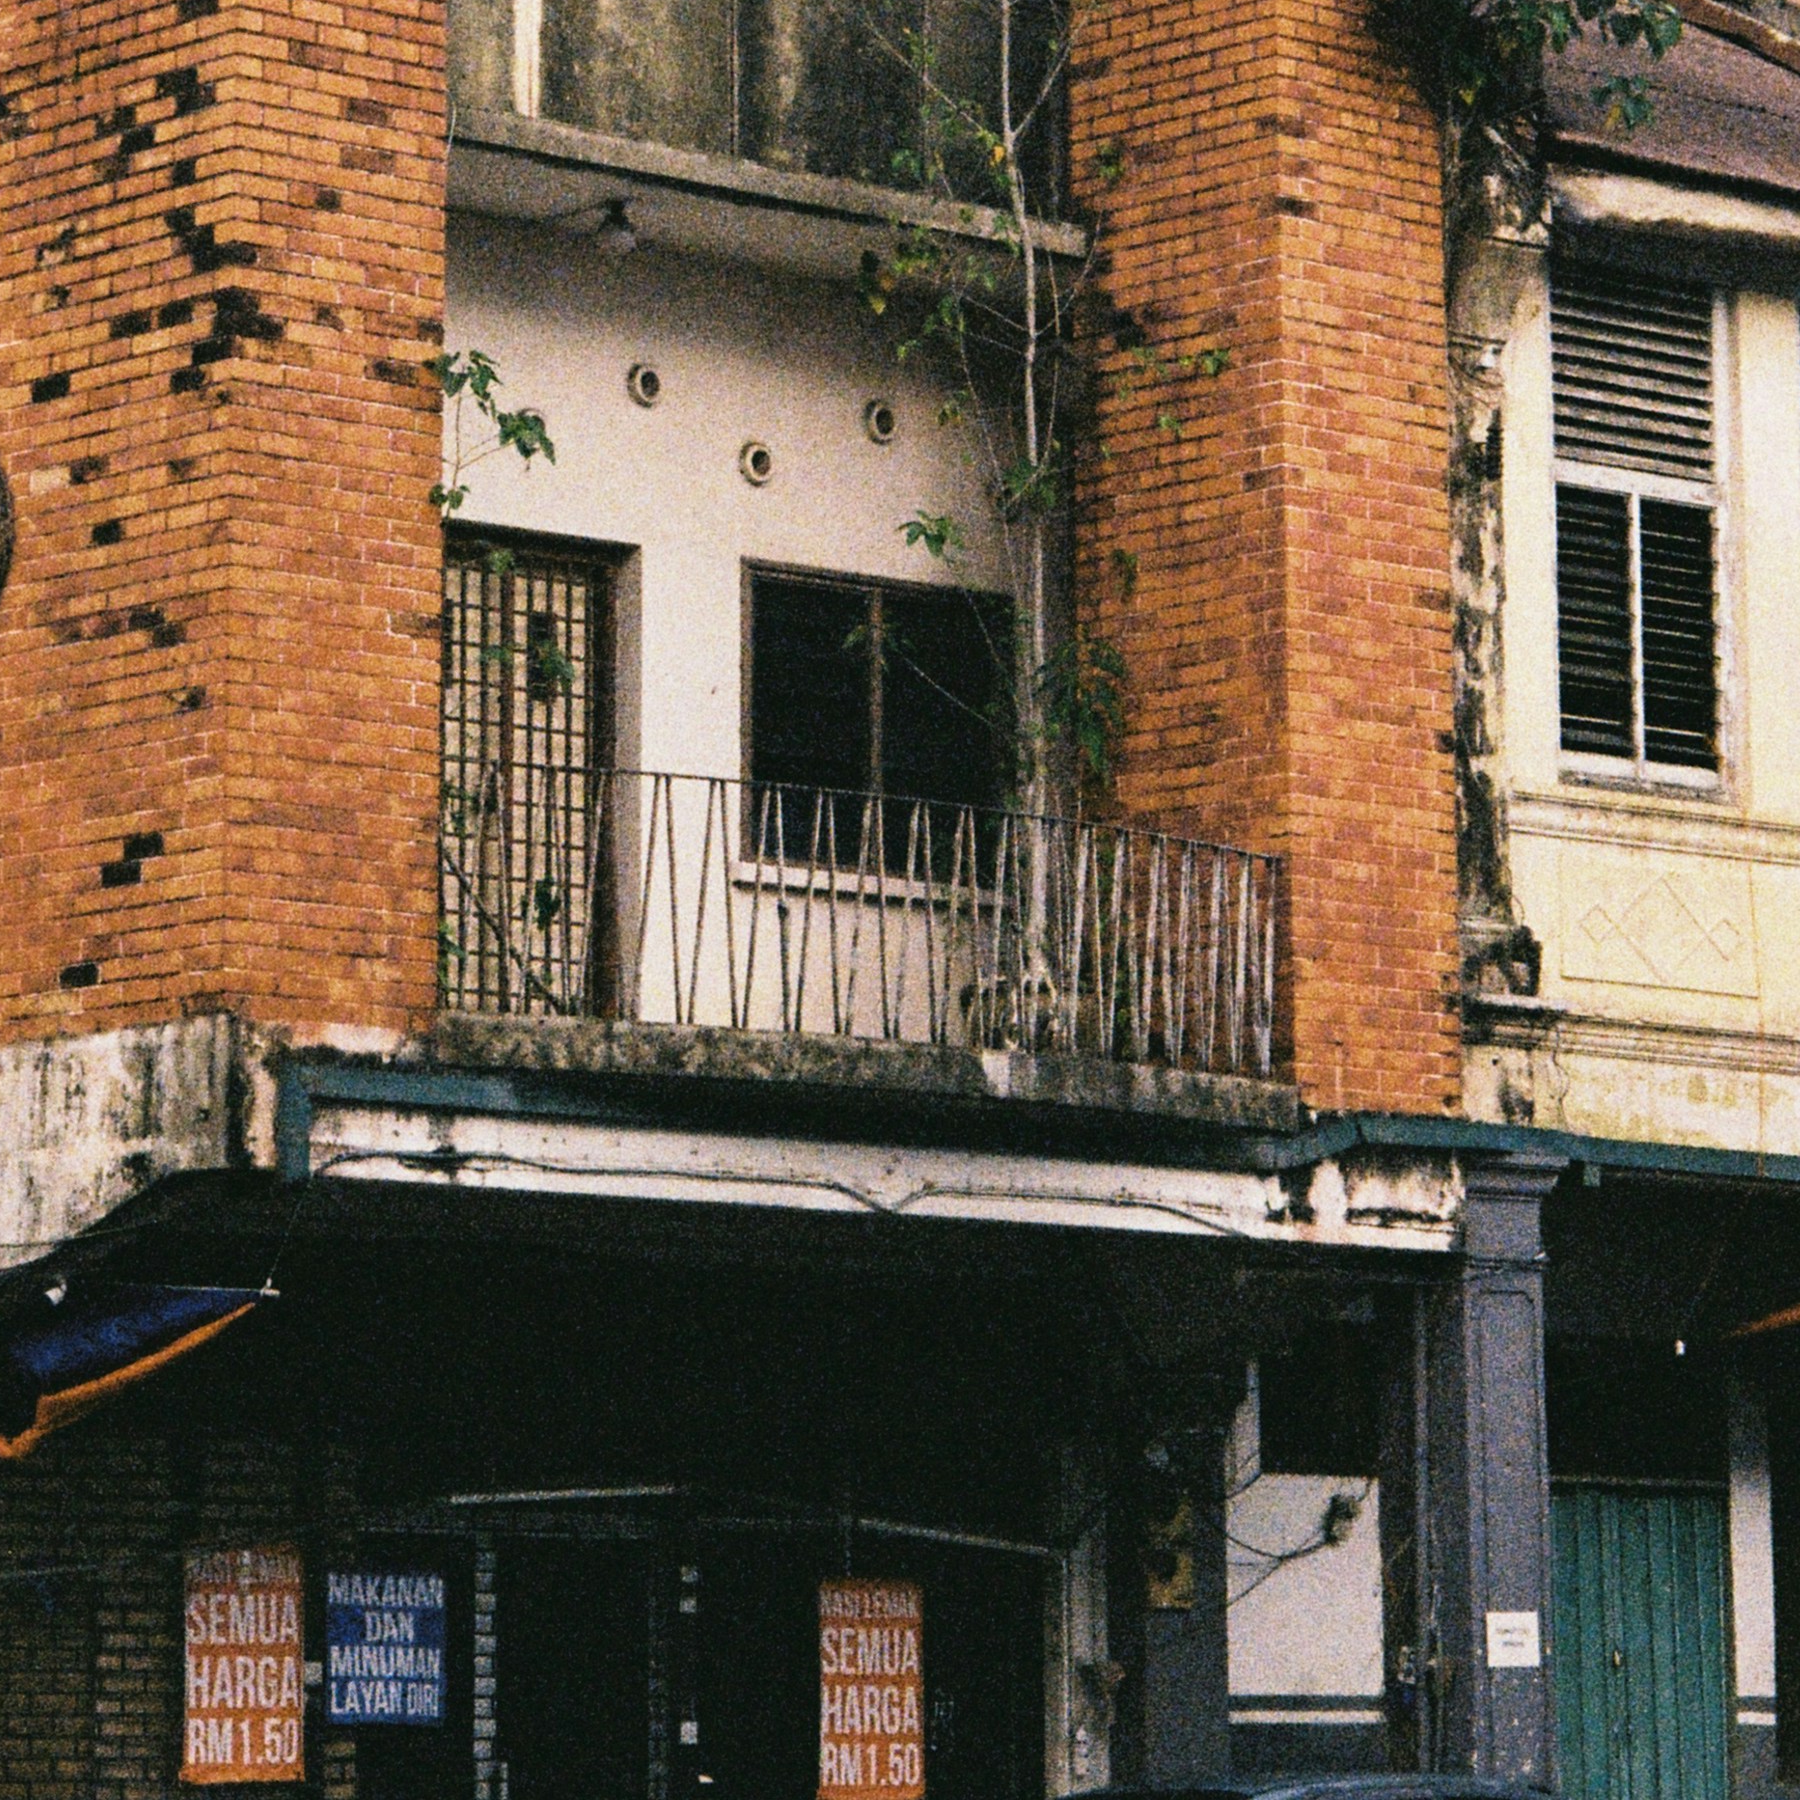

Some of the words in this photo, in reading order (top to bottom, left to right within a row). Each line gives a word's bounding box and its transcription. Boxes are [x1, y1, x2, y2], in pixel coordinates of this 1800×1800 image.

[328, 1572, 443, 1608] MAKANAN
[186, 1594, 299, 1644] SEMUA
[366, 1611, 414, 1642] DAN
[330, 1645, 441, 1679] MINUMAN
[821, 1627, 919, 1675] SEMUA
[188, 1656, 300, 1708] HARGA
[330, 1681, 402, 1714] LAYAN
[821, 1685, 920, 1734] HARGA
